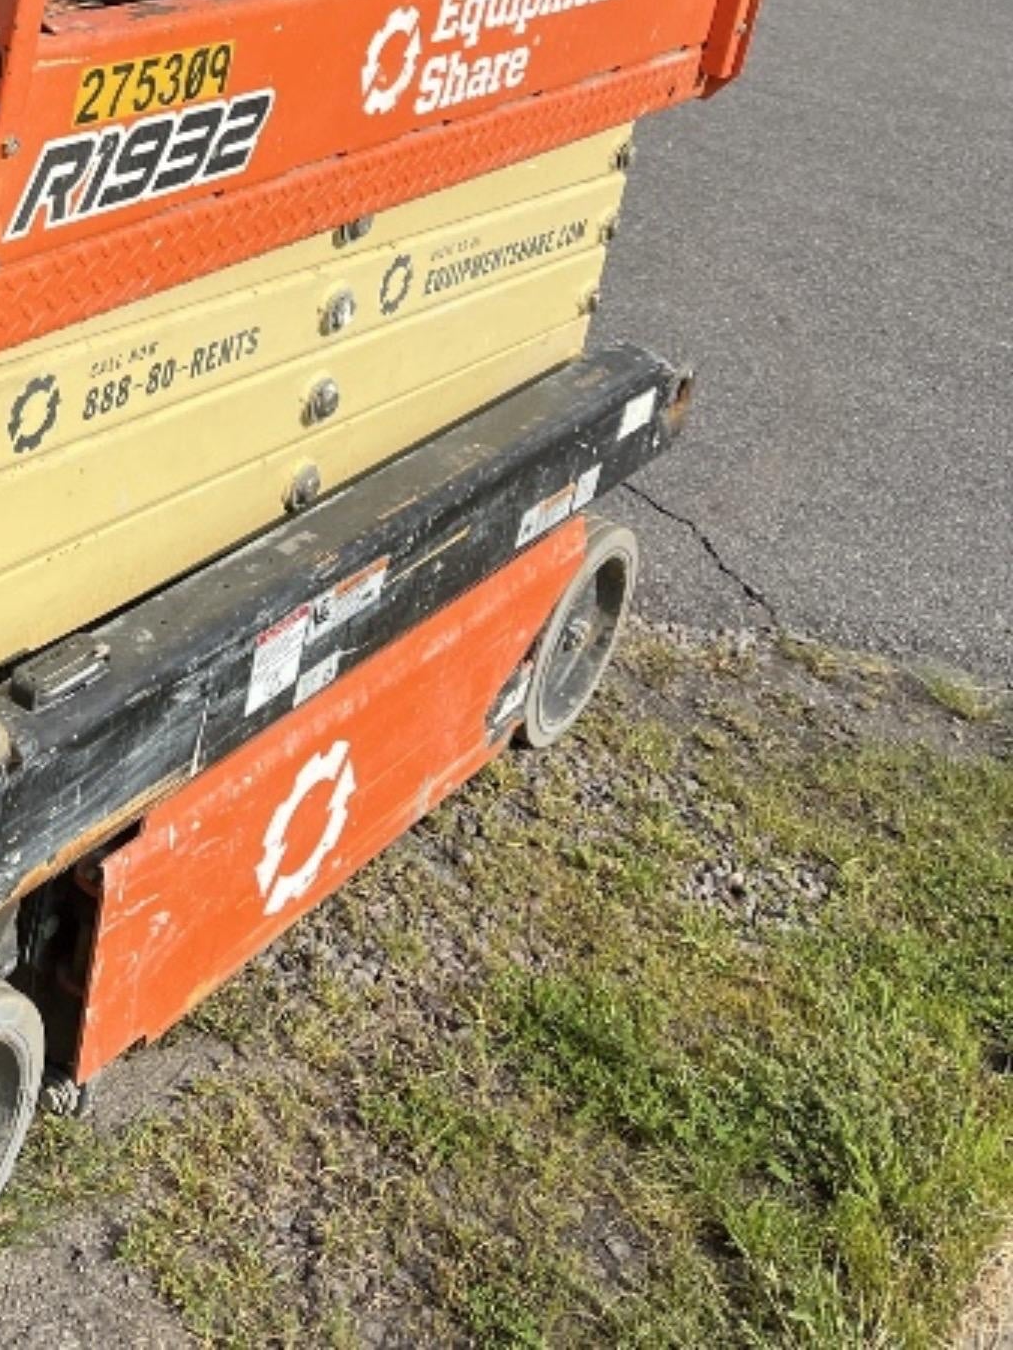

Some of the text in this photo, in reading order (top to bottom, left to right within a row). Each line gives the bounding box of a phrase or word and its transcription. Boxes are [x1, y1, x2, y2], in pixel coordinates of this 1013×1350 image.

[74, 44, 232, 125] 275309
[413, 45, 532, 116] Share
[2, 87, 277, 244] R1932
[82, 326, 261, 421] 888-80-RENTS
